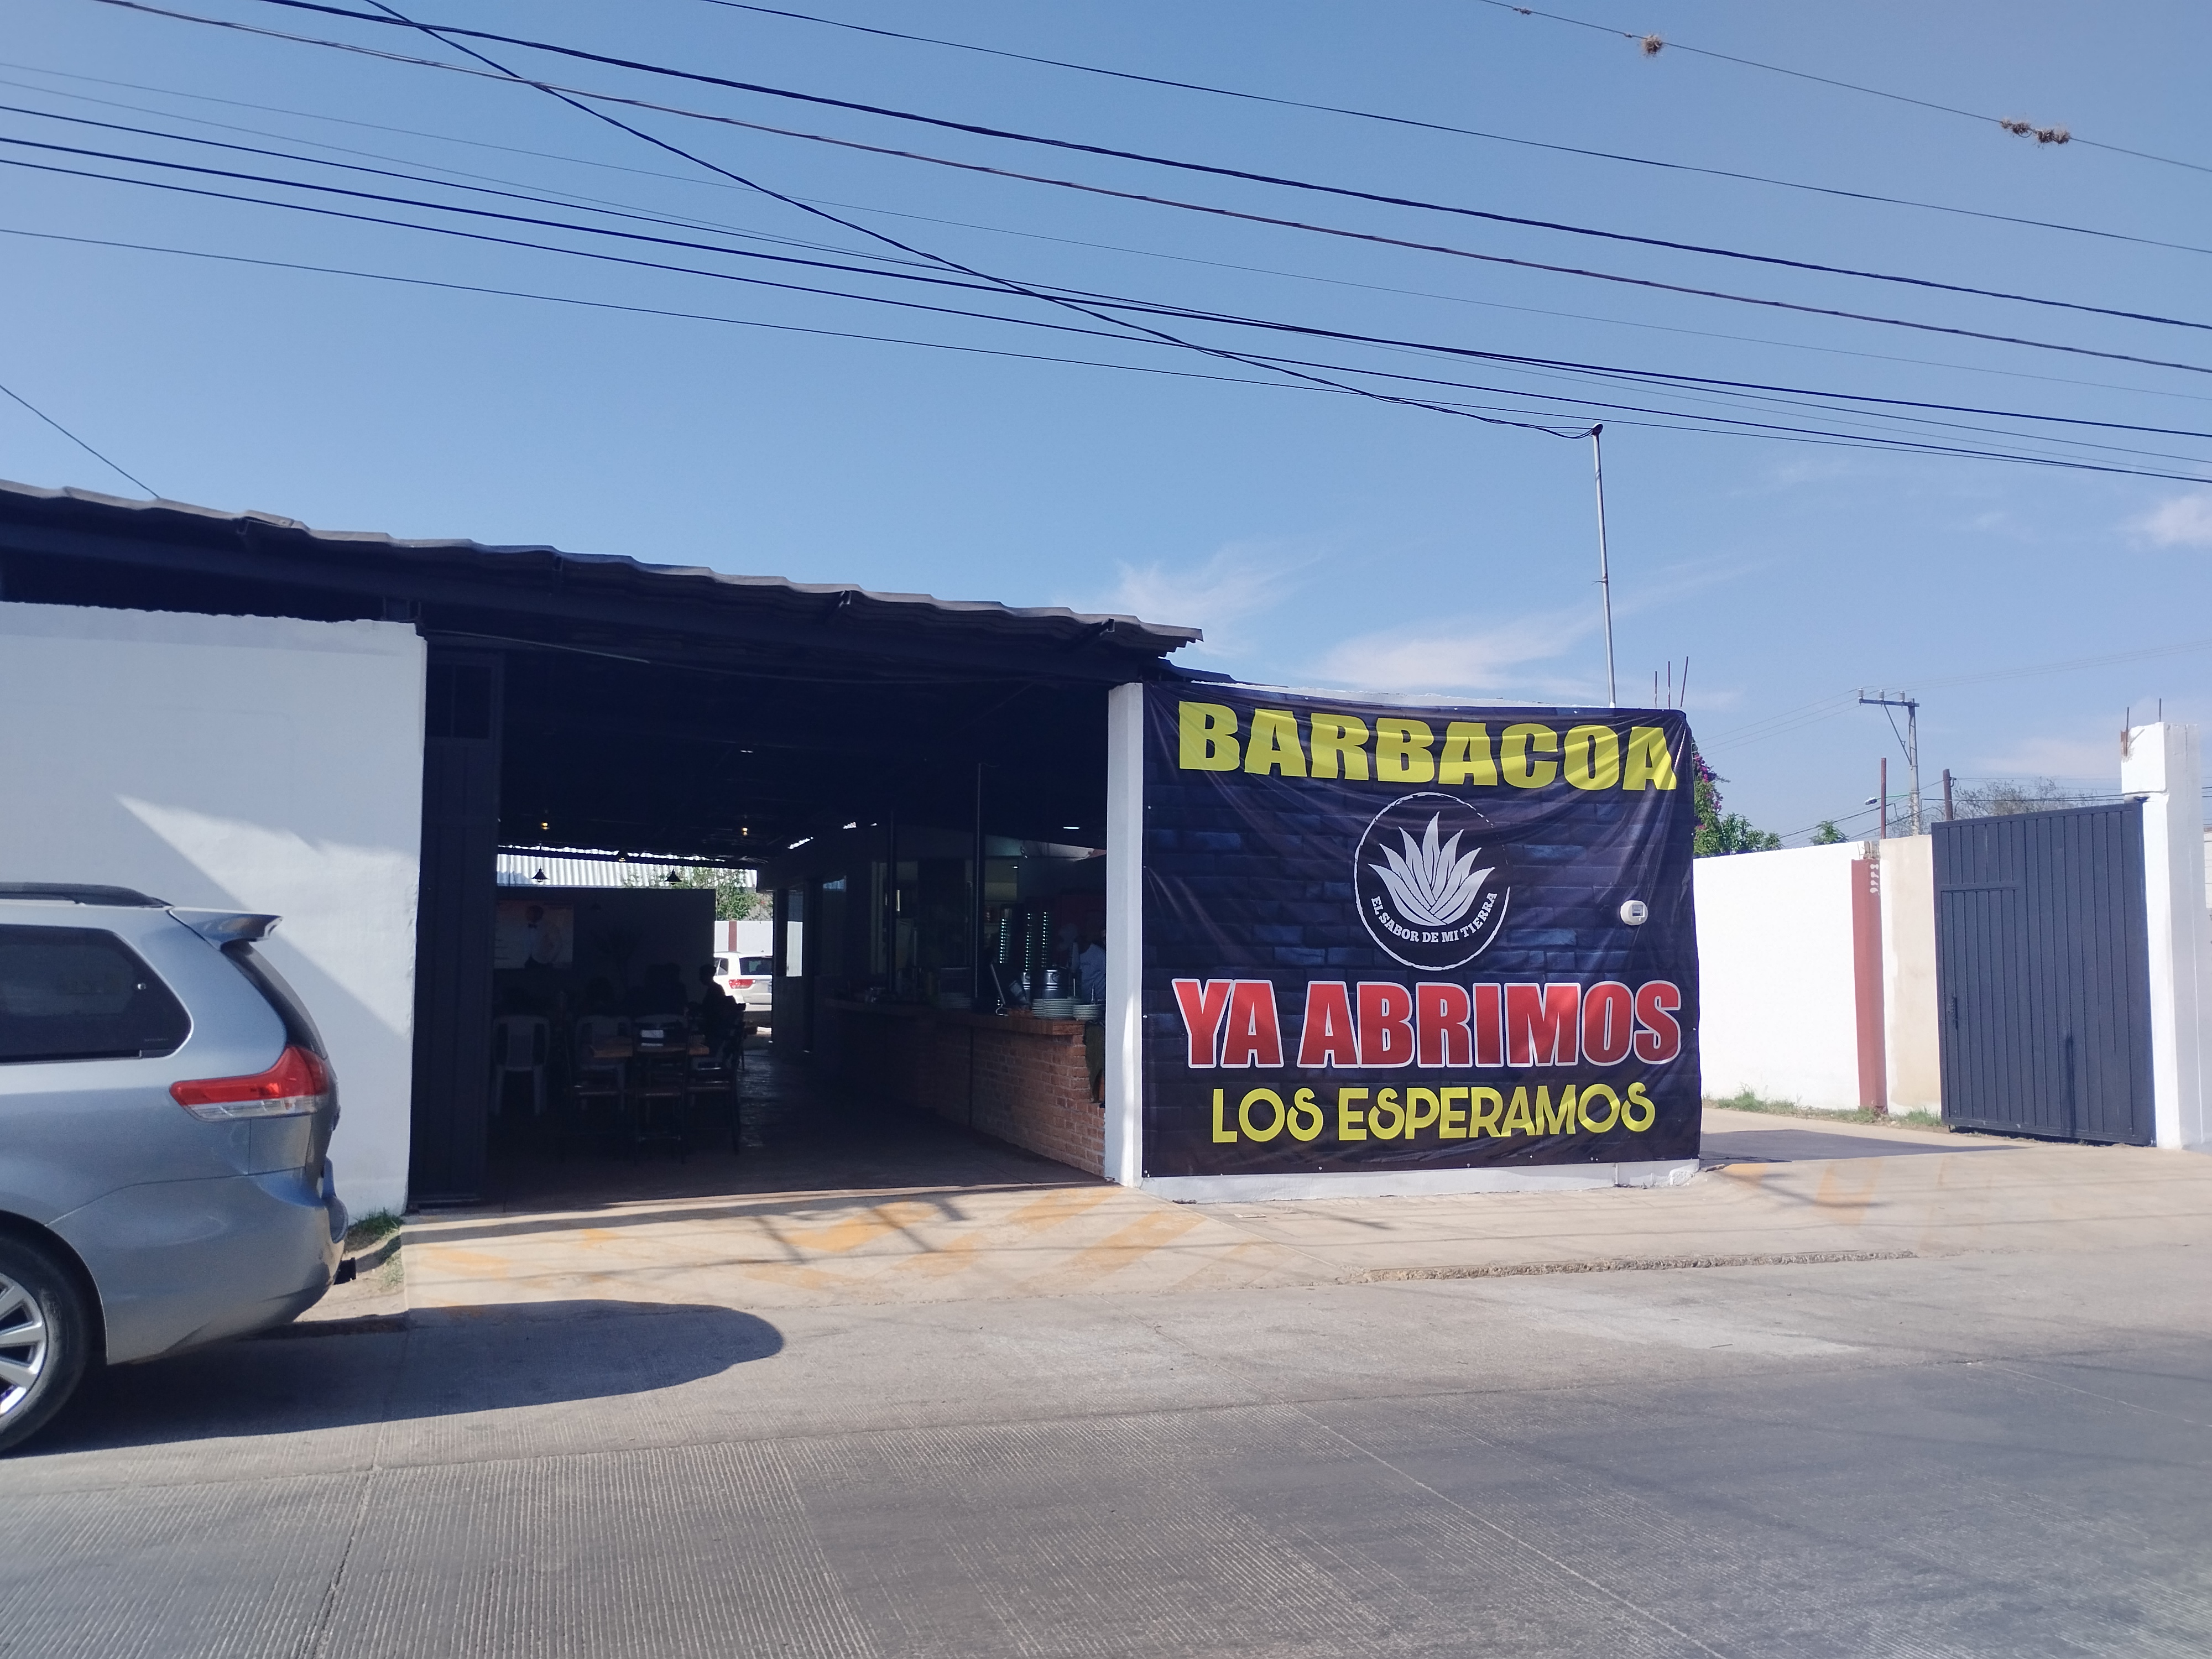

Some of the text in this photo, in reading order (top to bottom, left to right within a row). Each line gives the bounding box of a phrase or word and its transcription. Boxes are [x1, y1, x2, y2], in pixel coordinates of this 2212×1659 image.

[1178, 702, 1677, 790] BARBACOA
[1371, 893, 1498, 943] EL SABOR DE MI TIERRA
[1171, 978, 1682, 1068] YA ABRIMOS
[1212, 1082, 1655, 1143] LOS ESPERAMOS
